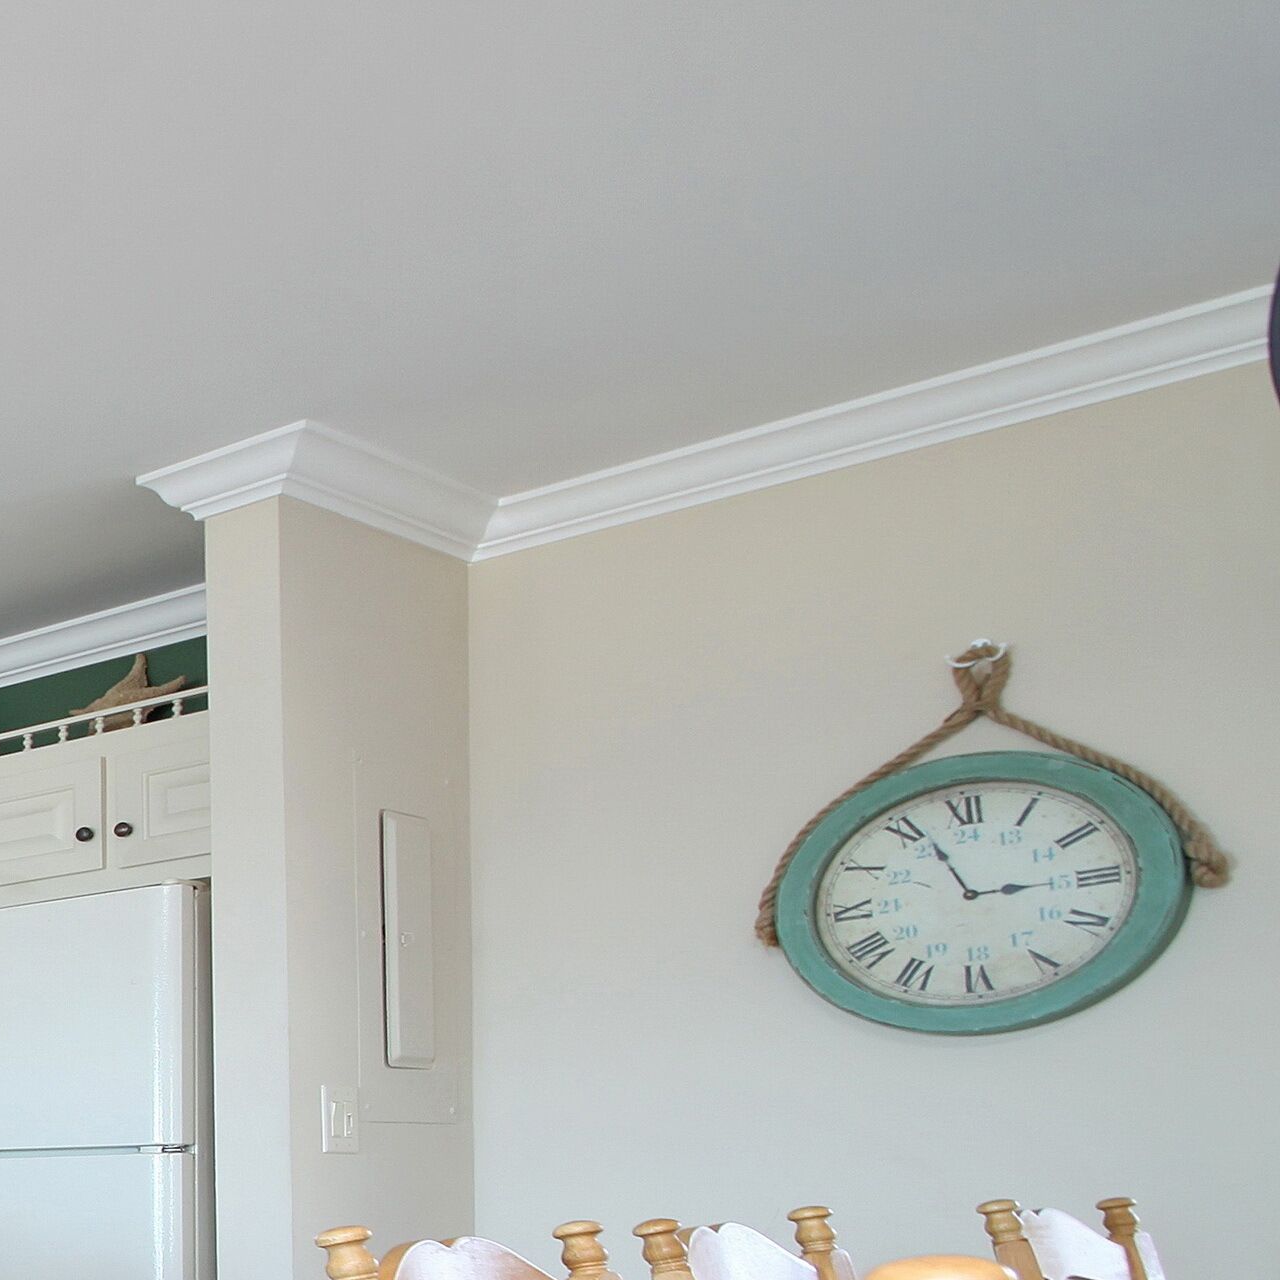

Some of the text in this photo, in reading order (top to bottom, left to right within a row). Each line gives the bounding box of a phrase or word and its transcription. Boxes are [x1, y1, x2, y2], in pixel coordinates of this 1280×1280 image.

[945, 795, 984, 829] XII
[884, 816, 925, 849] XI
[956, 828, 981, 845] 24
[1000, 830, 1023, 846] 13
[1054, 821, 1100, 849] II
[1032, 847, 1056, 862] 14
[844, 859, 887, 880] X
[887, 870, 911, 885] 22
[1075, 865, 1121, 888] III
[1049, 874, 1072, 891] 15
[833, 899, 873, 923] IX
[878, 898, 902, 914] 21
[1040, 907, 1063, 921] 16
[893, 925, 918, 941] 20
[1011, 930, 1034, 947] 17
[925, 943, 948, 959] 19
[967, 946, 990, 962] 18
